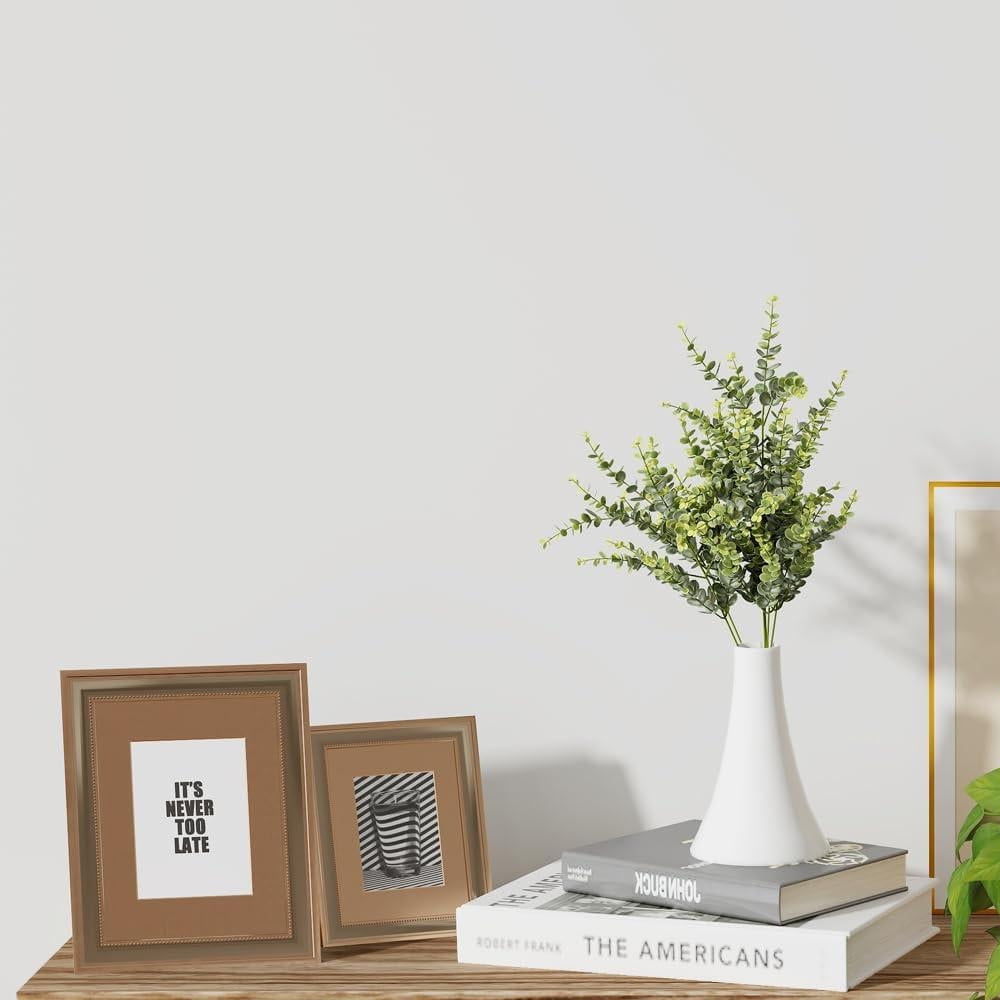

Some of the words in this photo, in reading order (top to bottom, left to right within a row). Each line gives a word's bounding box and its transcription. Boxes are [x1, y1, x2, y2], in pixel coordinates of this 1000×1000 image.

[174, 780, 204, 799] IT'S
[165, 799, 215, 818] NEVER
[174, 817, 207, 836] TOO
[174, 836, 210, 854] LATE
[487, 894, 539, 908] THE
[476, 936, 520, 951] ROBERT
[523, 939, 563, 955] FRANK
[583, 936, 629, 959] THE
[639, 940, 785, 970] AMERICANS
